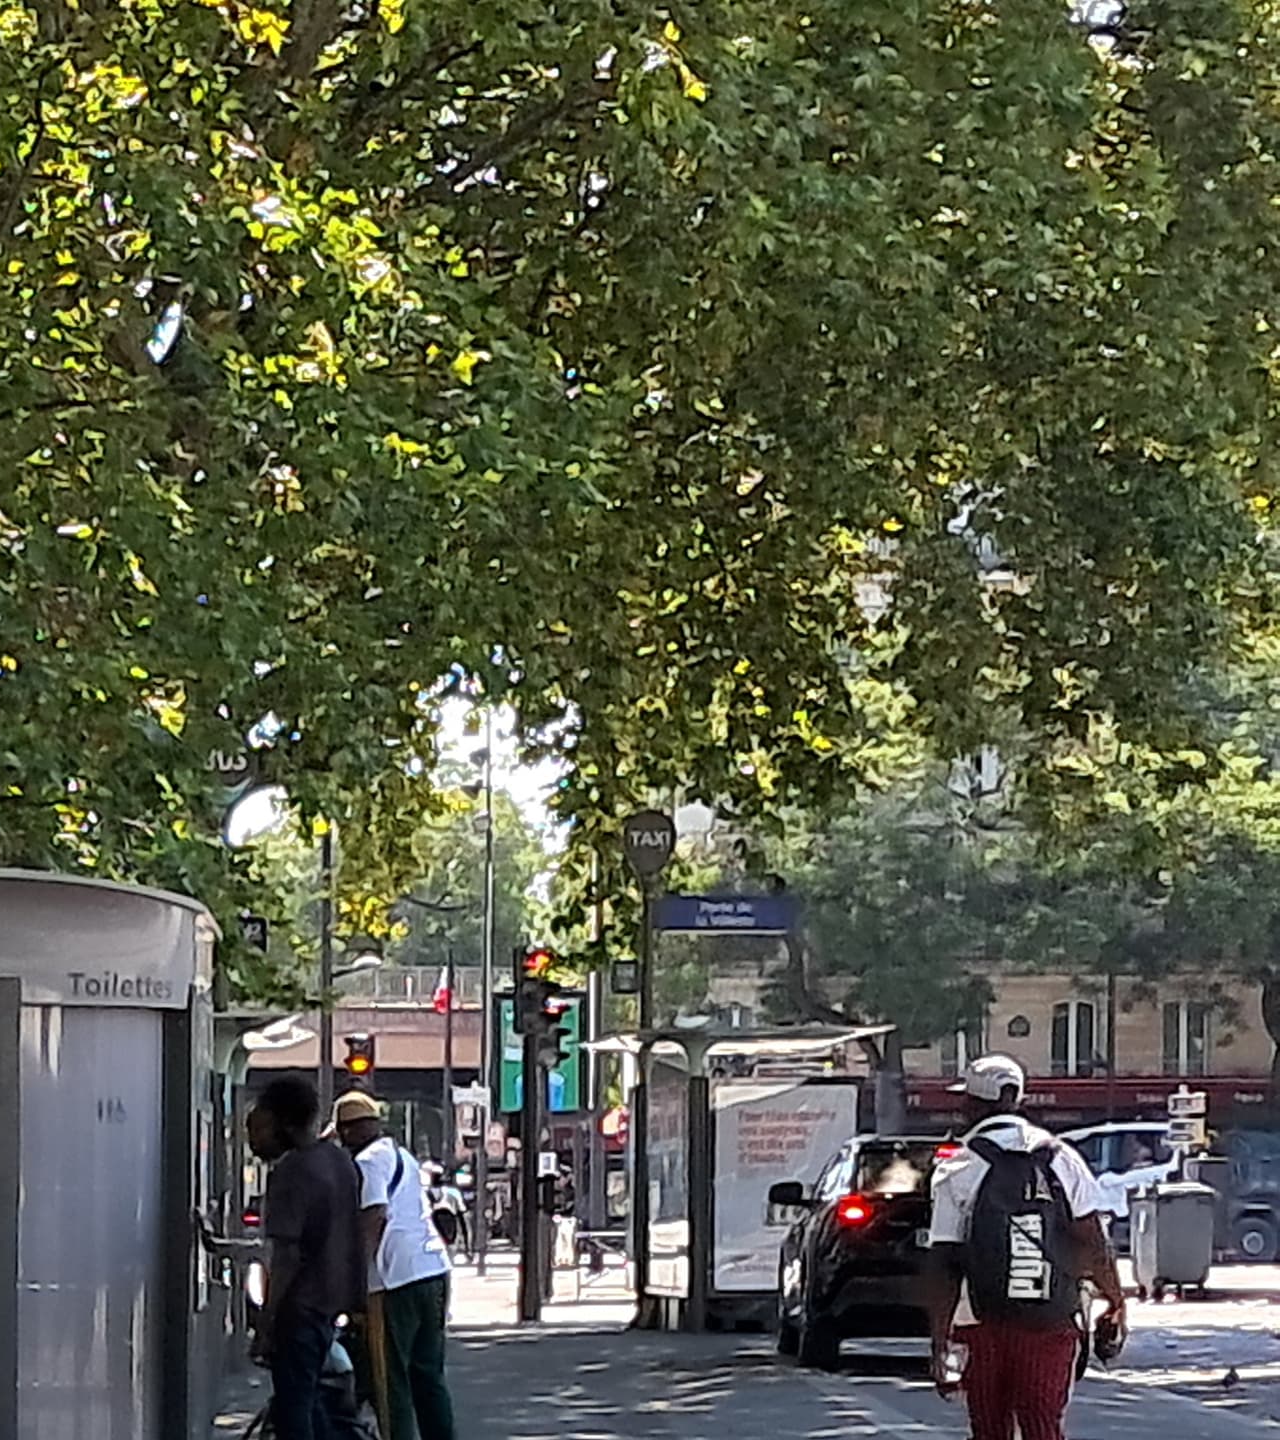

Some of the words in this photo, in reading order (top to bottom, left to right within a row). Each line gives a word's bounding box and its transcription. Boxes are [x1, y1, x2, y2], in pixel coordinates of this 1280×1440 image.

[630, 830, 671, 849] TAXI
[66, 970, 173, 999] Toilettes
[1008, 1213, 1048, 1299] PUMA
